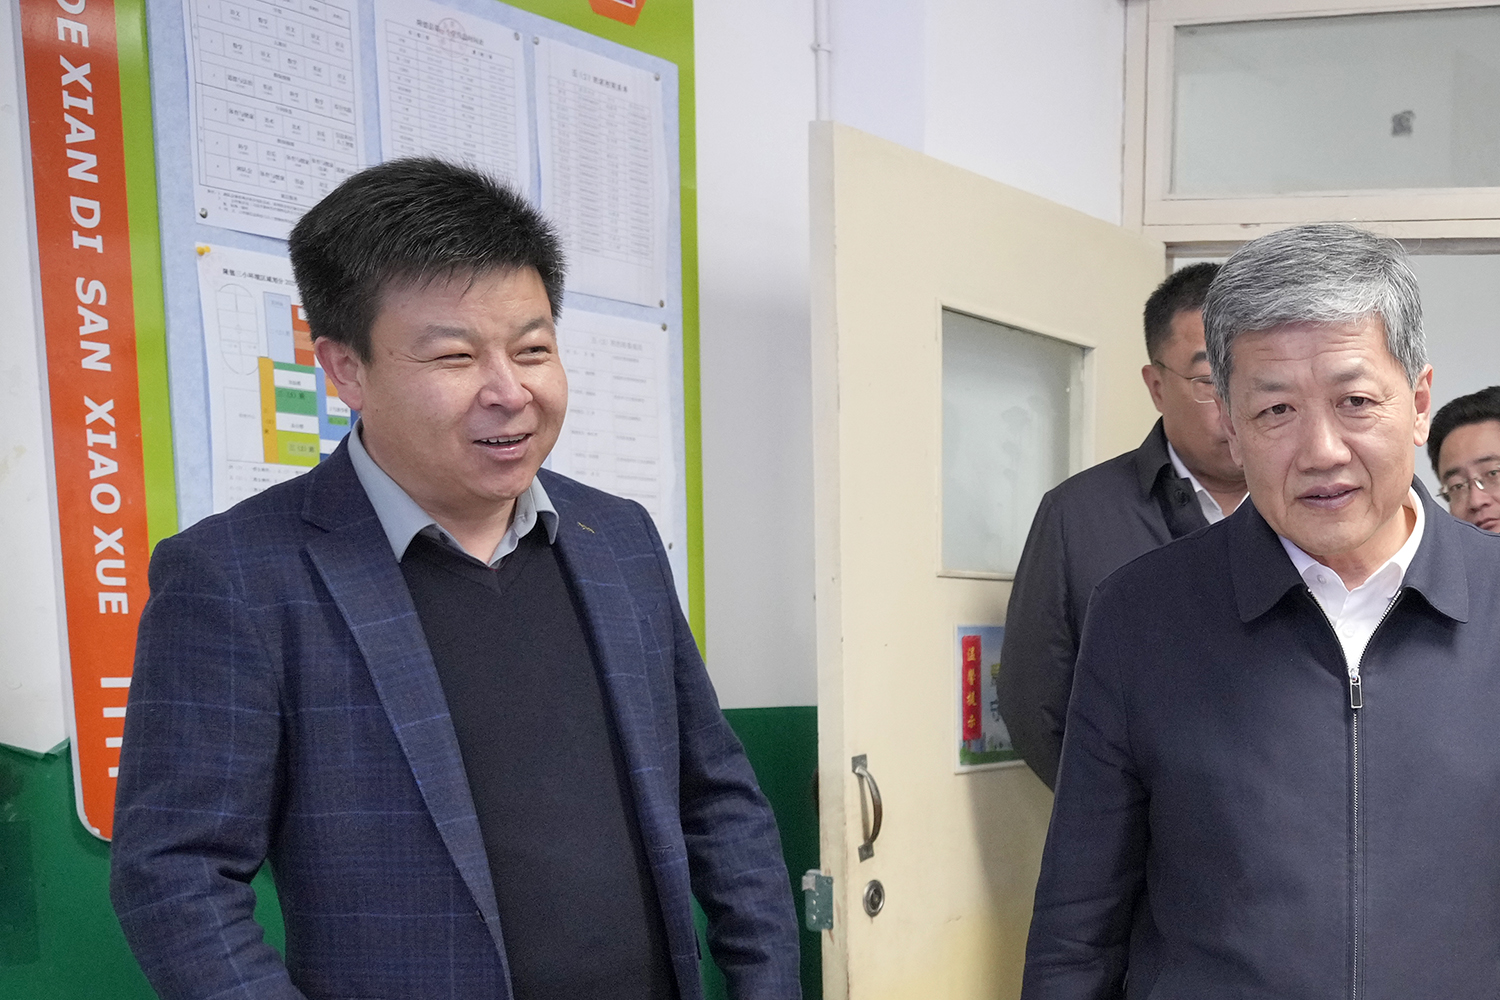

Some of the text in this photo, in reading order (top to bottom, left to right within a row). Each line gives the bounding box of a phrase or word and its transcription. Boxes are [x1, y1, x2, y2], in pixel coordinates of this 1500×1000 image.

[59, 55, 99, 183] XIAN
[69, 195, 104, 254] DI
[75, 276, 112, 372] SAN
[83, 395, 122, 514] XIAO
[93, 526, 129, 615] XUE
